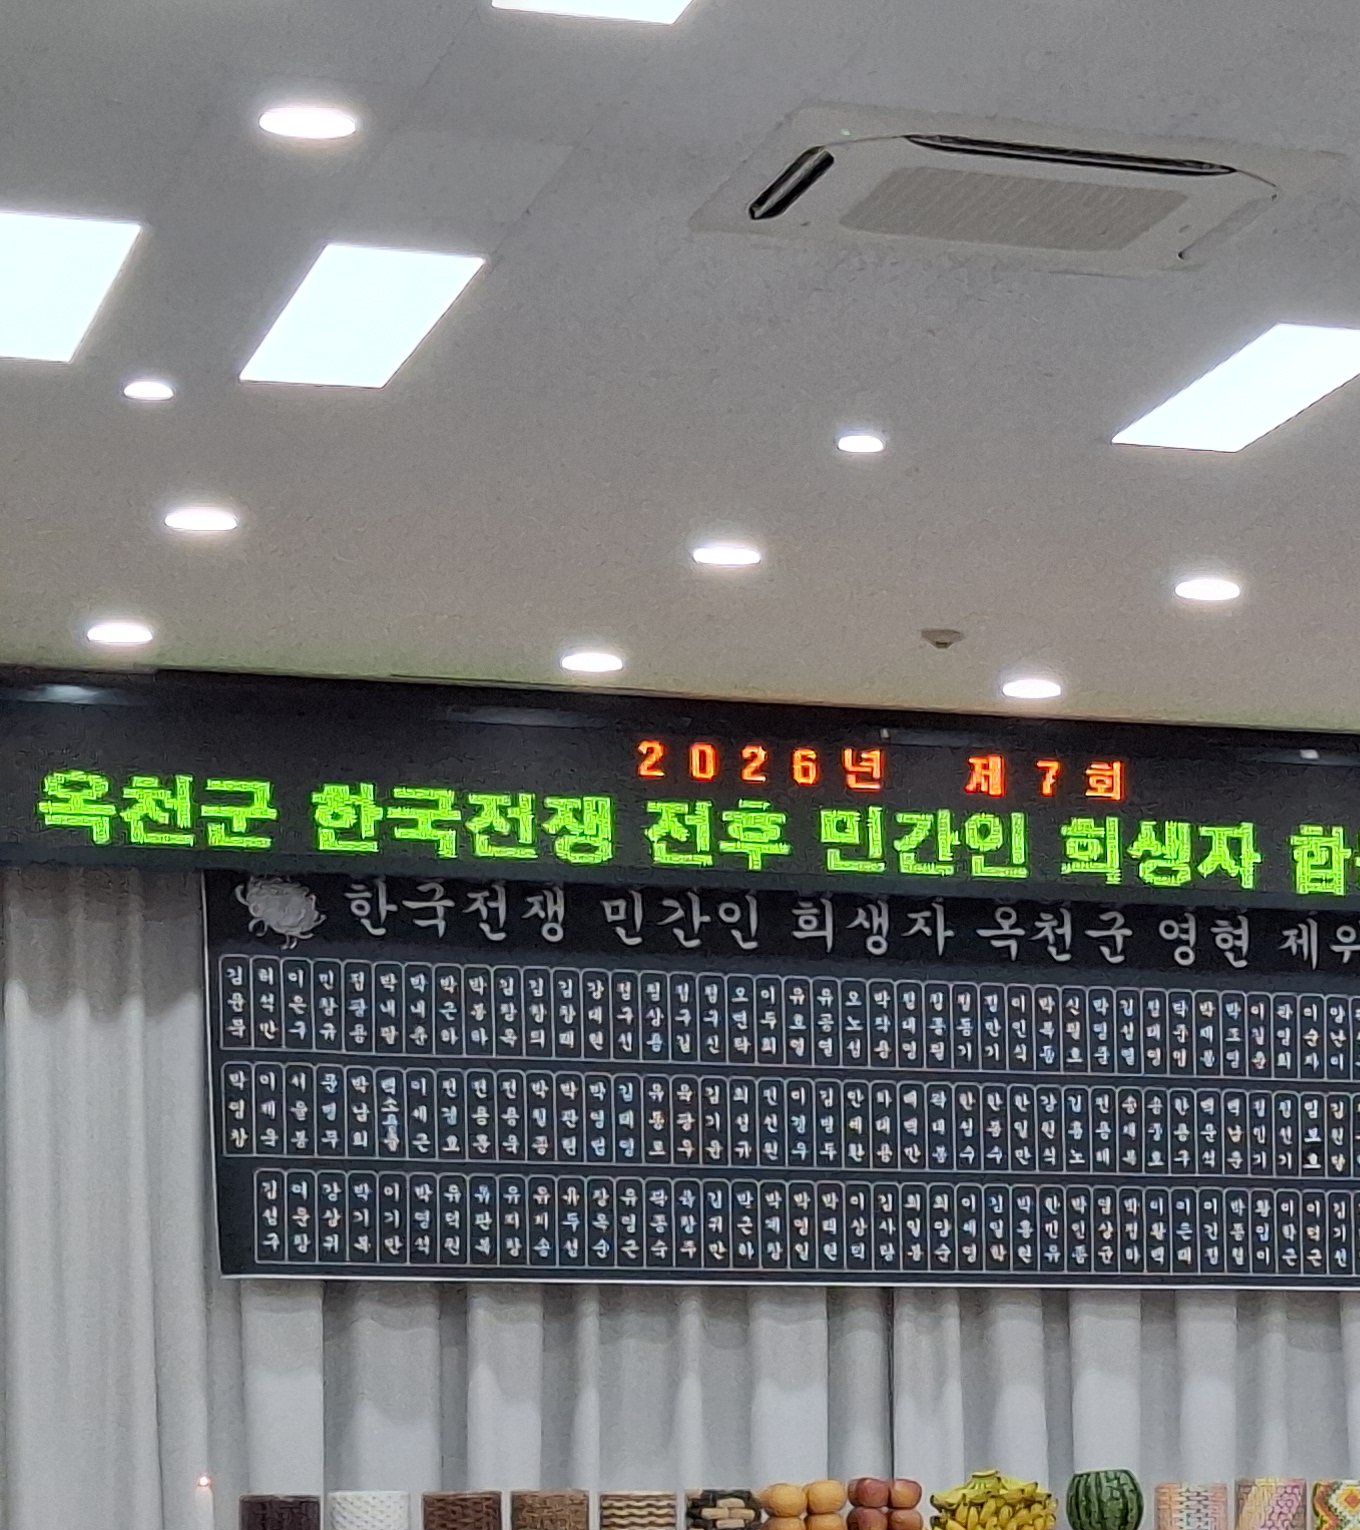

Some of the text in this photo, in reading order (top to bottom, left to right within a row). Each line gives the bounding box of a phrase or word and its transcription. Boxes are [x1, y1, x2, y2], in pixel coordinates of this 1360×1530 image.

[637, 740, 886, 793] 2026년
[38, 769, 279, 849] 옥천군
[311, 781, 617, 865] 한국전쟁
[646, 798, 792, 872] 전후
[820, 805, 1029, 879] 민간인
[1060, 815, 1263, 888] 희생자
[344, 881, 566, 943] 한국전쟁
[602, 890, 759, 950] 민간인
[791, 898, 955, 955] 희생자
[975, 905, 1134, 964] 옥천군
[1158, 914, 1250, 968] 영현
